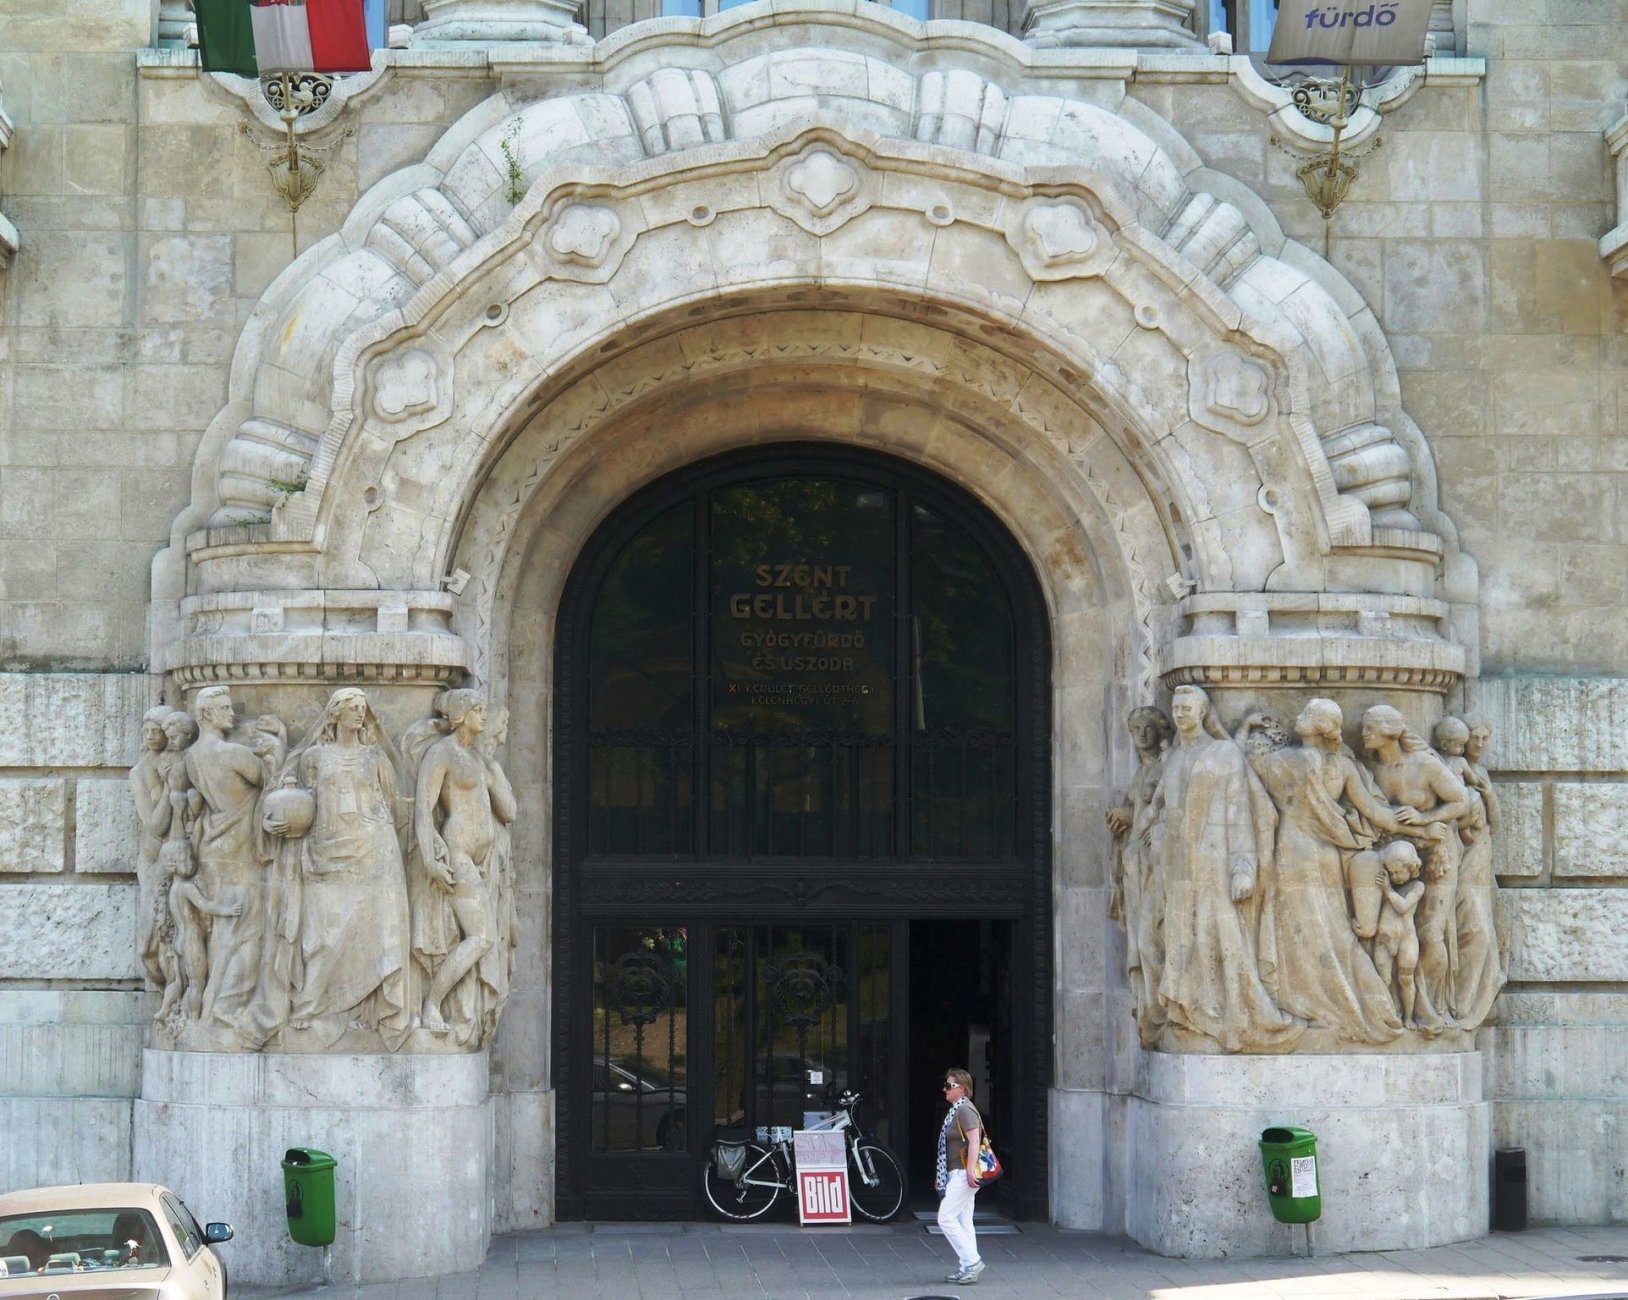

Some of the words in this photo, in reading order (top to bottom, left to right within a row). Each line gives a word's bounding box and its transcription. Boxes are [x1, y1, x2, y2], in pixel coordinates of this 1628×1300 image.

[1305, 3, 1399, 29] fürdő
[755, 564, 852, 588] SZENT
[729, 589, 877, 621] GELLÉRT
[752, 653, 775, 671] ÉS
[781, 656, 854, 671] USZODA
[804, 1176, 843, 1214] Bild
